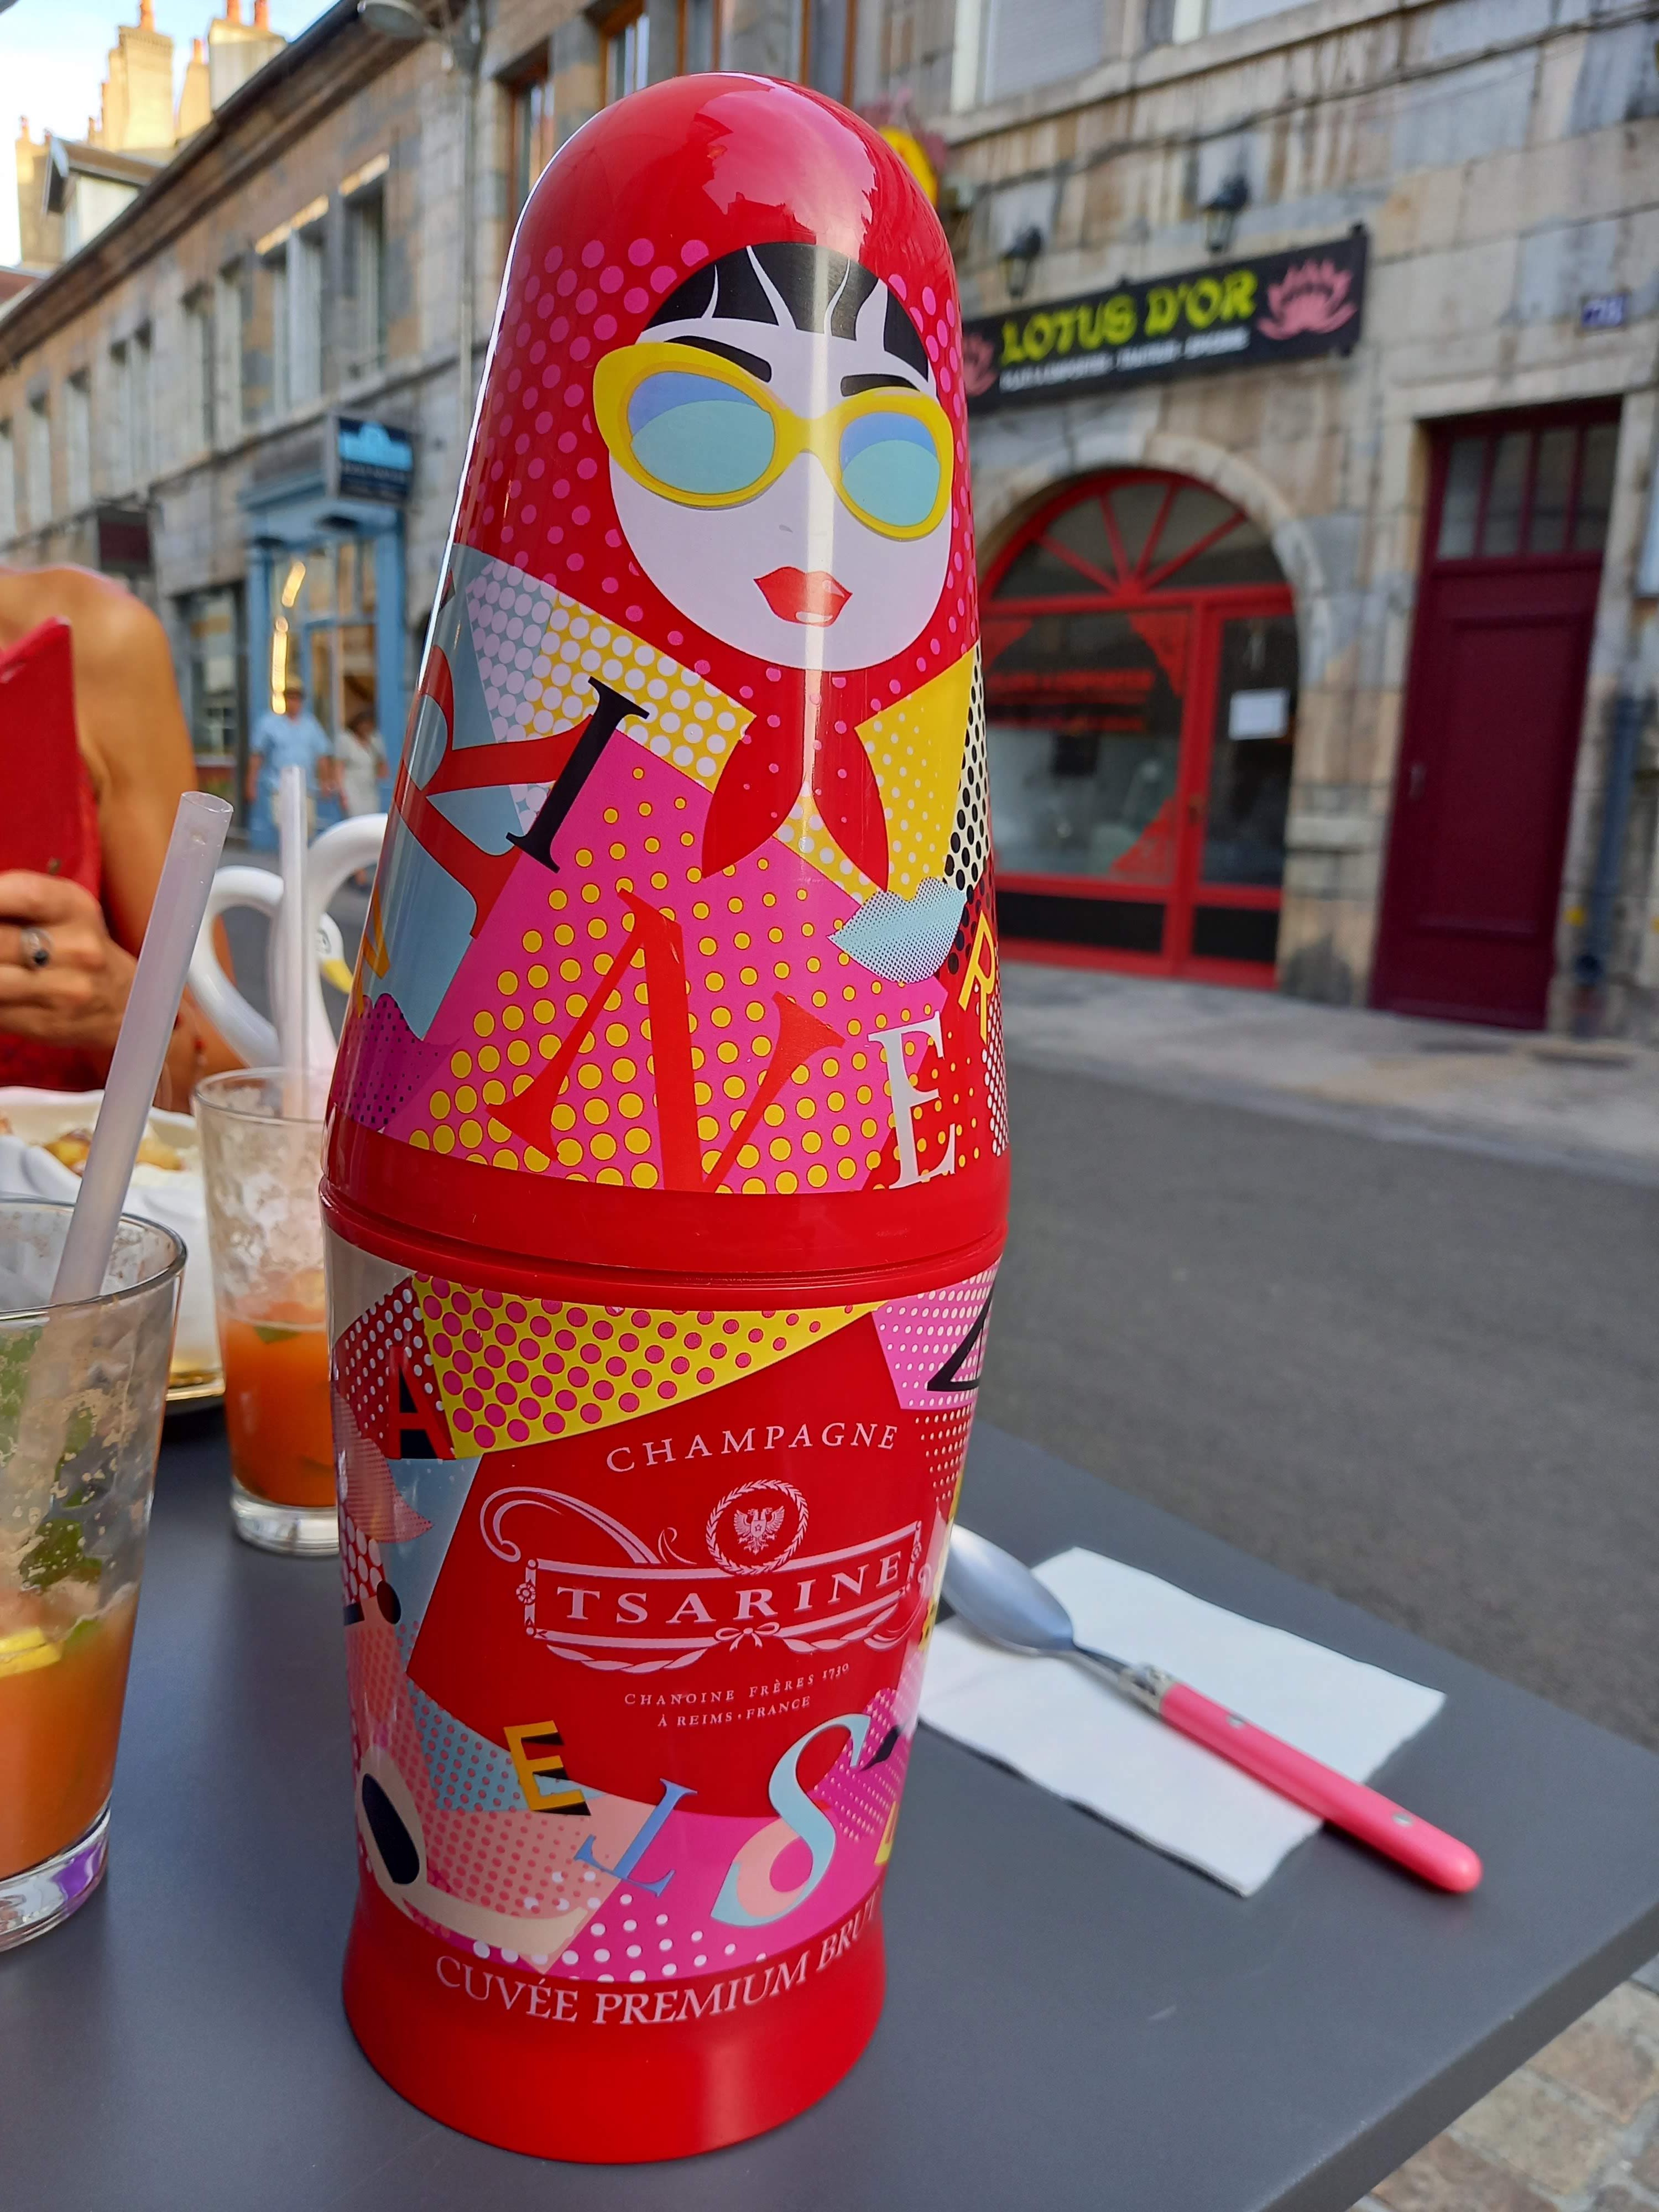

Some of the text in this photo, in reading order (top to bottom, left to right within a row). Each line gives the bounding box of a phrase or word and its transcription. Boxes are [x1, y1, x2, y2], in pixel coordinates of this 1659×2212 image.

[1001, 293, 1137, 367] LOTUS
[1145, 269, 1258, 336] D'OR
[606, 1421, 898, 1473] CHAMPAGNE
[556, 1550, 902, 1625] TSARINE
[624, 1662, 851, 1707] CHANOINE FRÈRES 1730
[436, 1955, 580, 2024] CUVÉE
[593, 1950, 811, 2026] PREMIUM
